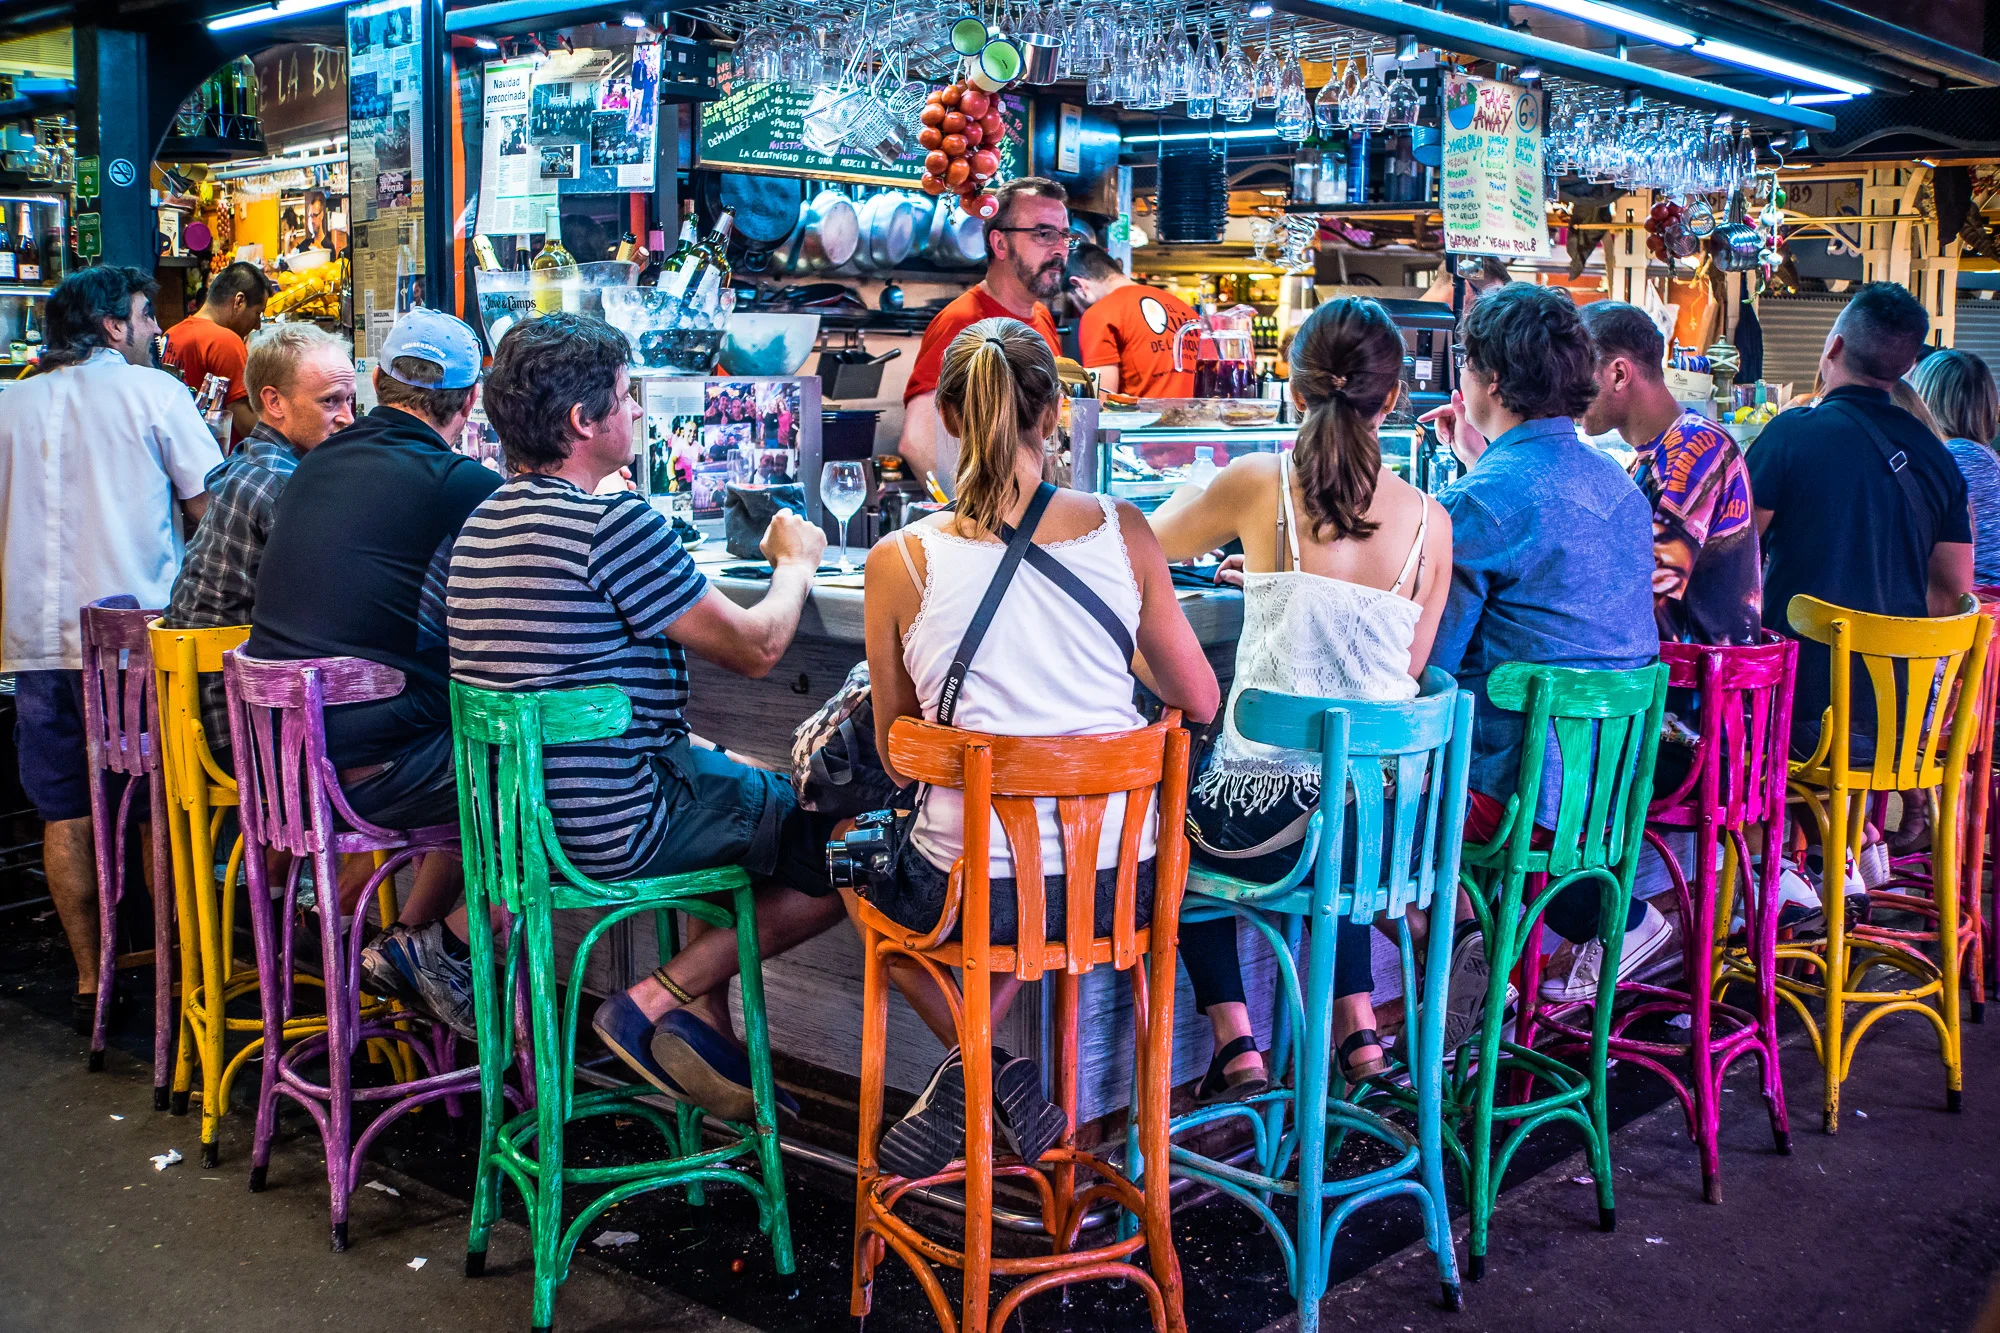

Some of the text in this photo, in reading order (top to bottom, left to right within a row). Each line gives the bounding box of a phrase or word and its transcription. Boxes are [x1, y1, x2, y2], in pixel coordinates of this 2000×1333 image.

[278, 51, 298, 105] LA
[493, 76, 520, 89] Navidad
[486, 90, 526, 106] precocinada
[1480, 87, 1510, 114] TAKE
[1473, 106, 1513, 135] AWAY
[805, 154, 815, 163] ES
[840, 158, 866, 169] MEZCLA
[507, 295, 537, 311] Camps
[1151, 341, 1165, 353] DE
[1667, 430, 1717, 493] MOBB DEEP
[940, 676, 958, 721] SAMSUNG
